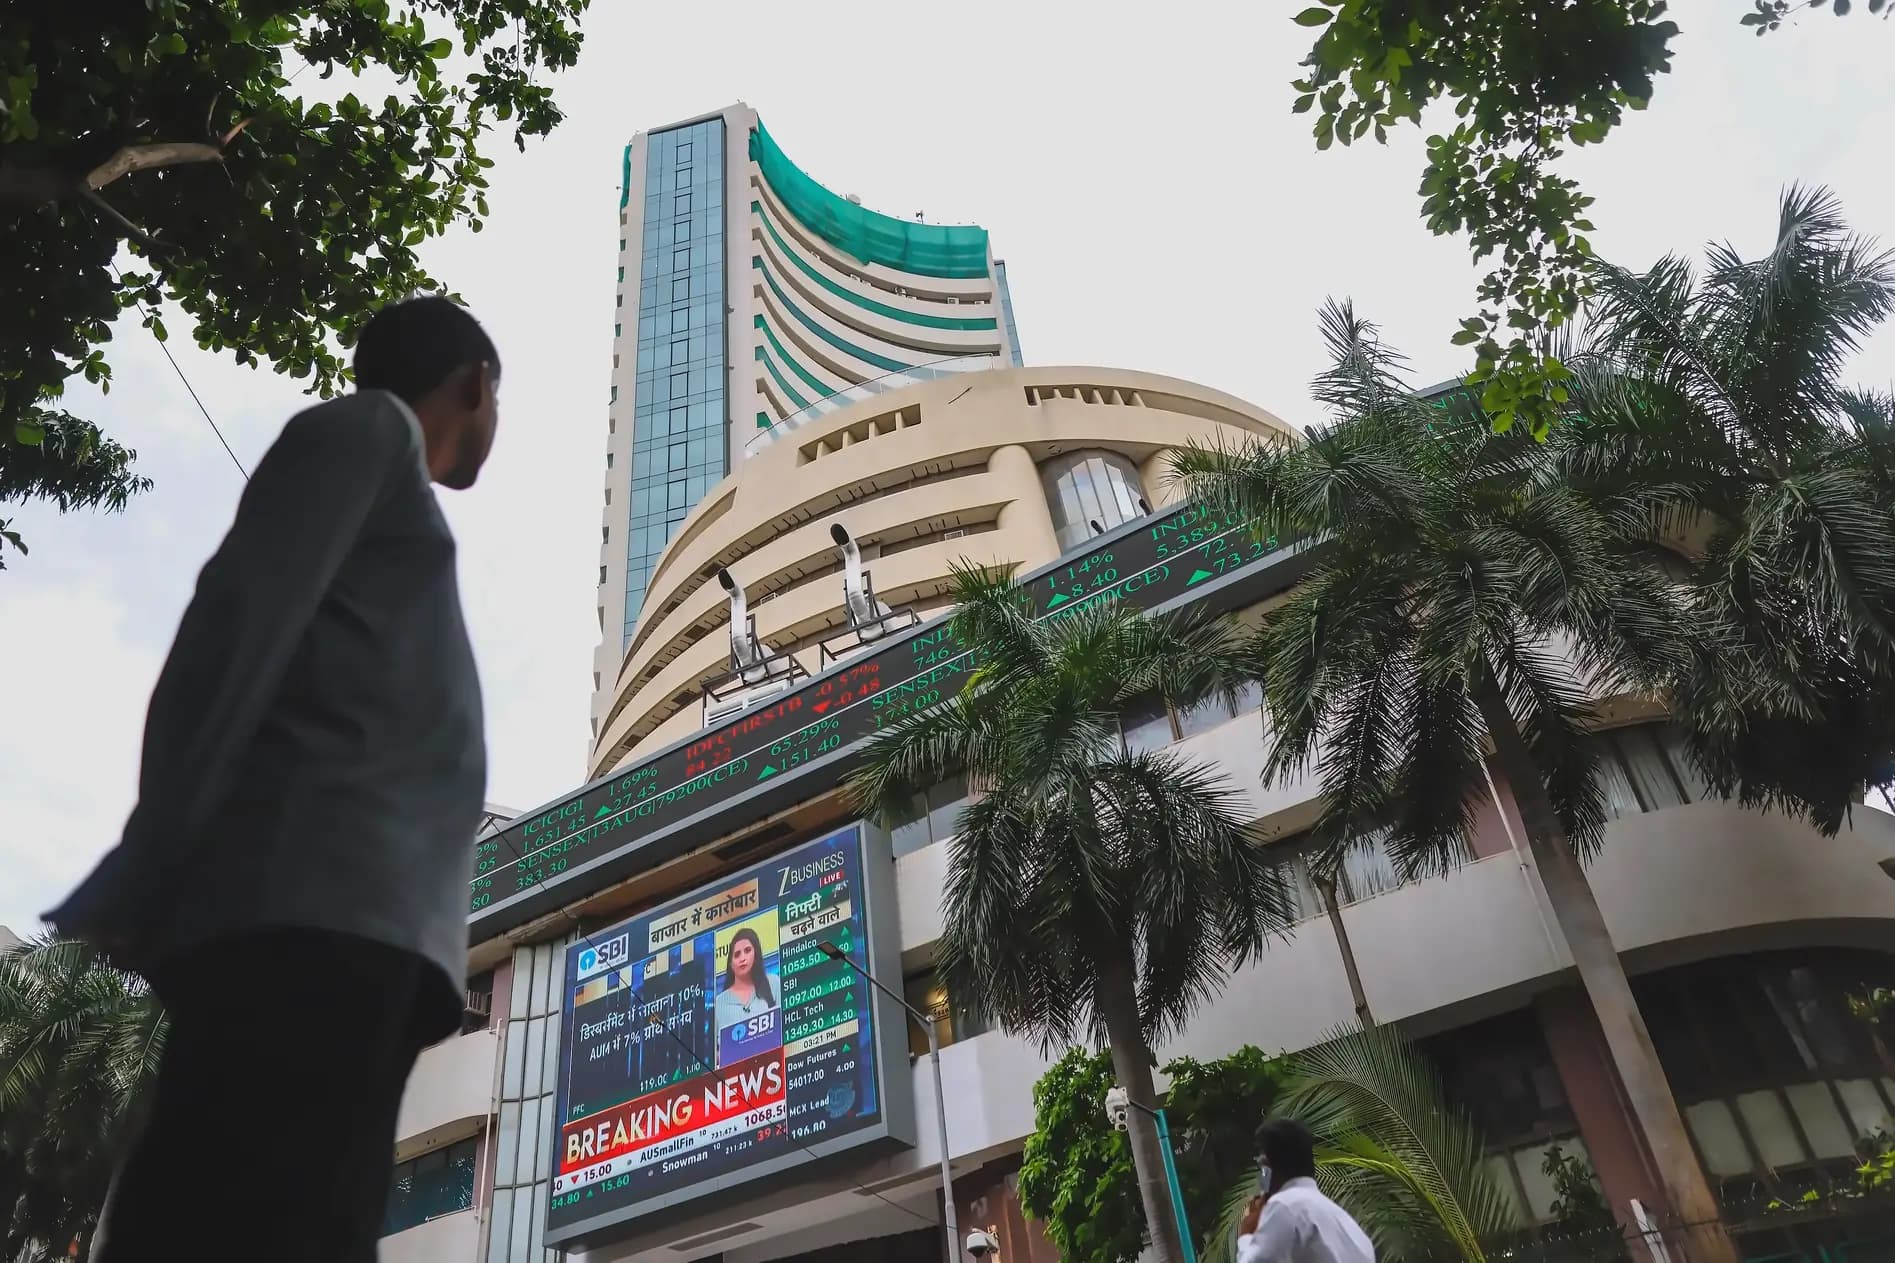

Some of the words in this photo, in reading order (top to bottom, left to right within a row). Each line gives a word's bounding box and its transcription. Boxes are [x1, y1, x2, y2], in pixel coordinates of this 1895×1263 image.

[1049, 550, 1113, 589] 1.14%
[1072, 568, 1117, 597] 8.40
[769, 715, 839, 757] 65.29%
[780, 734, 841, 772] 151.40
[608, 763, 658, 797] 1.69%
[613, 782, 657, 812] 27.45
[523, 799, 584, 837] ICICIGI
[516, 858, 568, 891] 383.30
[791, 851, 845, 886] BUSINESS
[824, 871, 841, 885] LIVE
[650, 918, 688, 944] बाजार
[705, 889, 757, 921] कारोबार
[785, 892, 822, 922] निफ्टी
[598, 936, 627, 964] SBI
[783, 939, 817, 958] Hindalco
[783, 952, 821, 977] 1053.50
[784, 978, 797, 992] SBI
[784, 984, 822, 1009] 1097.00
[829, 975, 851, 991] 12.00
[748, 1012, 774, 1036] SBI
[785, 1011, 800, 1025] HCL
[804, 1002, 824, 1018] Tech
[785, 1018, 824, 1042] 1349.30
[831, 1008, 853, 1025] 14.30
[803, 1035, 823, 1049] 03:21
[827, 1030, 837, 1041] PM
[788, 1058, 804, 1072] Dow
[807, 1048, 837, 1065] Futures
[836, 1060, 855, 1073] 4.00
[567, 1094, 693, 1165] BREAKING
[704, 1061, 782, 1118] NEWS
[790, 1104, 807, 1118] MCX
[810, 1096, 830, 1111] Lead
[584, 1163, 612, 1182] 15.00
[640, 1136, 694, 1164] AUSmallFin
[601, 1174, 630, 1193] 15.60
[662, 1151, 708, 1174] Snowman
